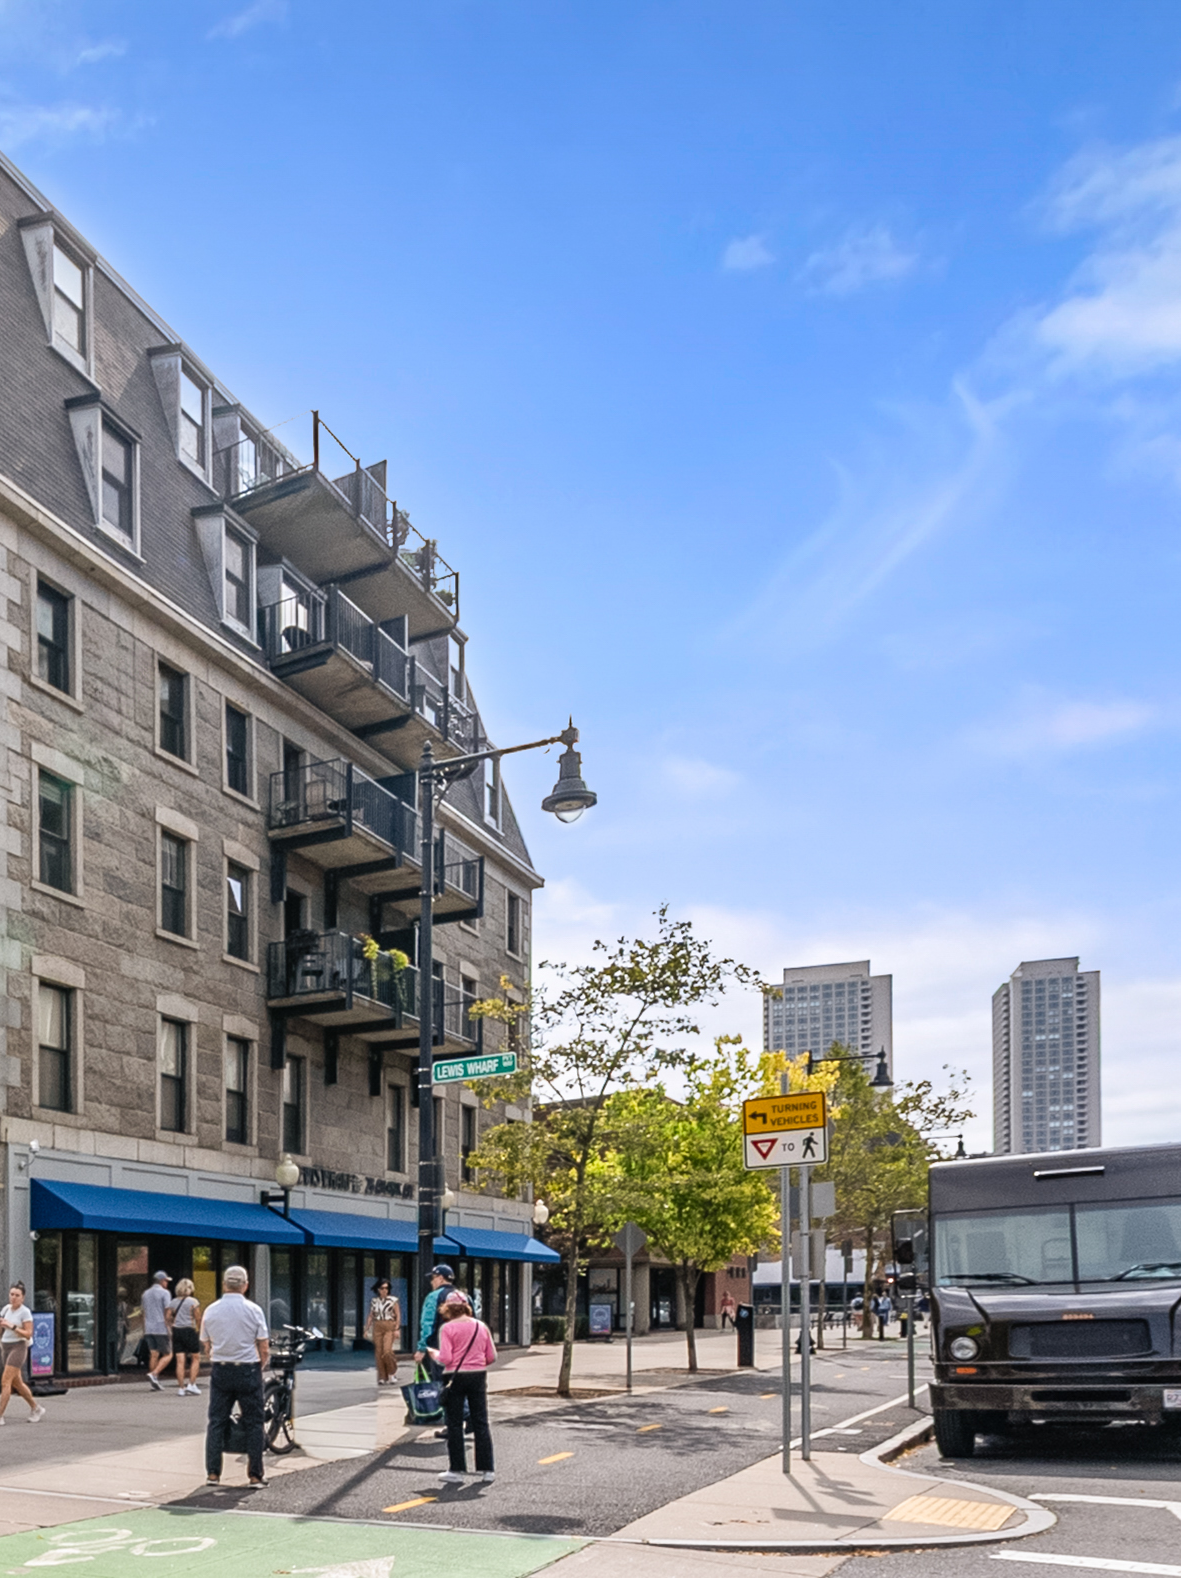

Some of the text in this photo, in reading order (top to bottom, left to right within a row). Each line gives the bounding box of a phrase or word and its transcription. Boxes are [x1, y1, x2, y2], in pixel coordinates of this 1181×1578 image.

[436, 1059, 499, 1079] LEWIS WHARF
[771, 1101, 817, 1113] TURNING
[770, 1113, 819, 1126] VEHICLES
[781, 1143, 795, 1152] TO
